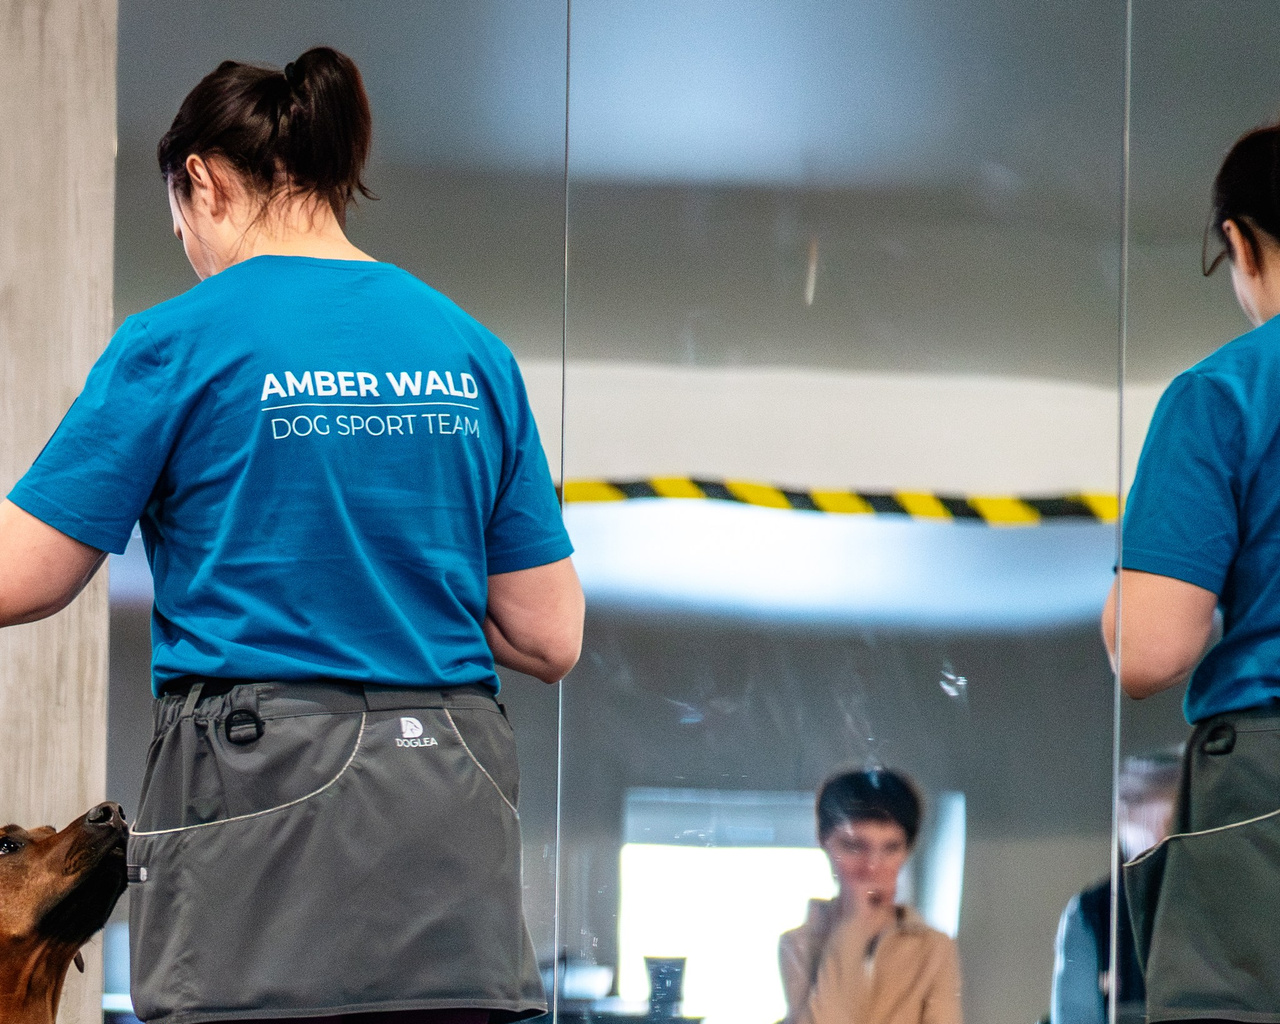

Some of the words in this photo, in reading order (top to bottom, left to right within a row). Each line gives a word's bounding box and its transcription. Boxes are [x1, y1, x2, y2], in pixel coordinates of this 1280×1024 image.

[261, 370, 380, 401] AMBER
[385, 370, 479, 400] WALD
[271, 414, 330, 440] DOG
[336, 414, 417, 436] SPORT
[422, 413, 480, 438] TEAM
[395, 737, 438, 748] DOGLEA
